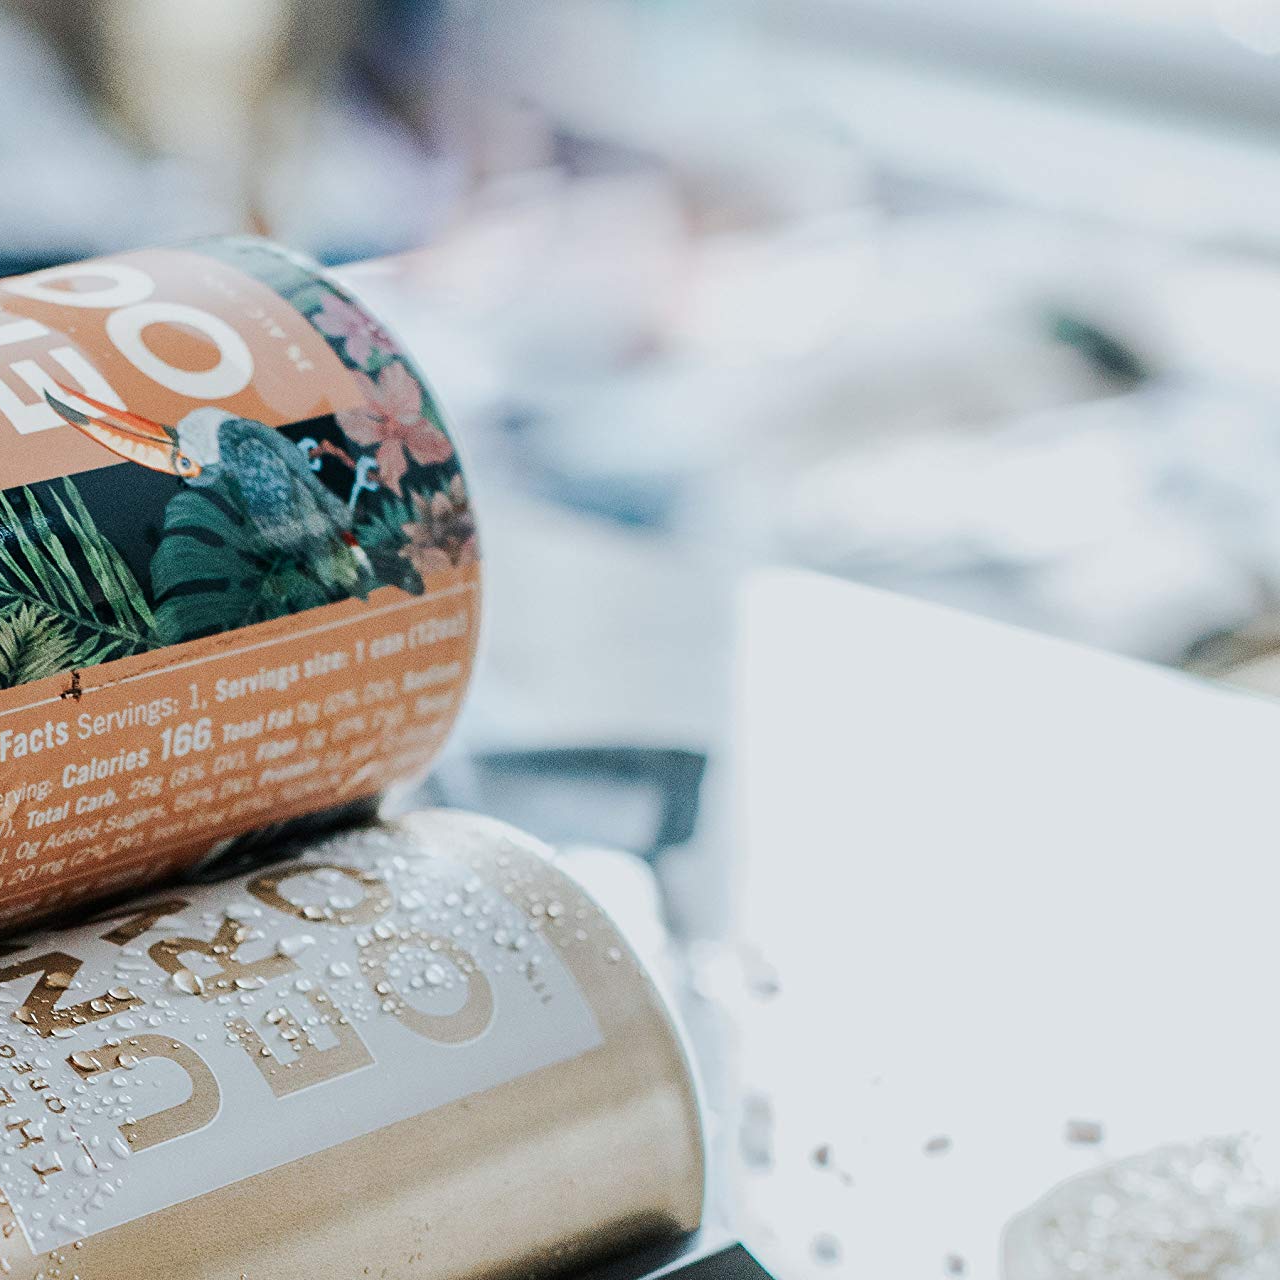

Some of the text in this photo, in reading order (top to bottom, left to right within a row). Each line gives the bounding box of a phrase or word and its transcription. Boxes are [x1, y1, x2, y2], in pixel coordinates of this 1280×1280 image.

[0, 720, 69, 763] Facts
[77, 697, 179, 740] Servings:
[188, 682, 209, 712] 1,
[215, 664, 300, 702] Servings
[62, 748, 149, 789] Calories
[27, 801, 70, 830] Total
[128, 775, 164, 800] 25g
[16, 840, 40, 860] 0g
[44, 819, 103, 851] Added
[8, 864, 35, 887] 20
[38, 857, 66, 877] mg
